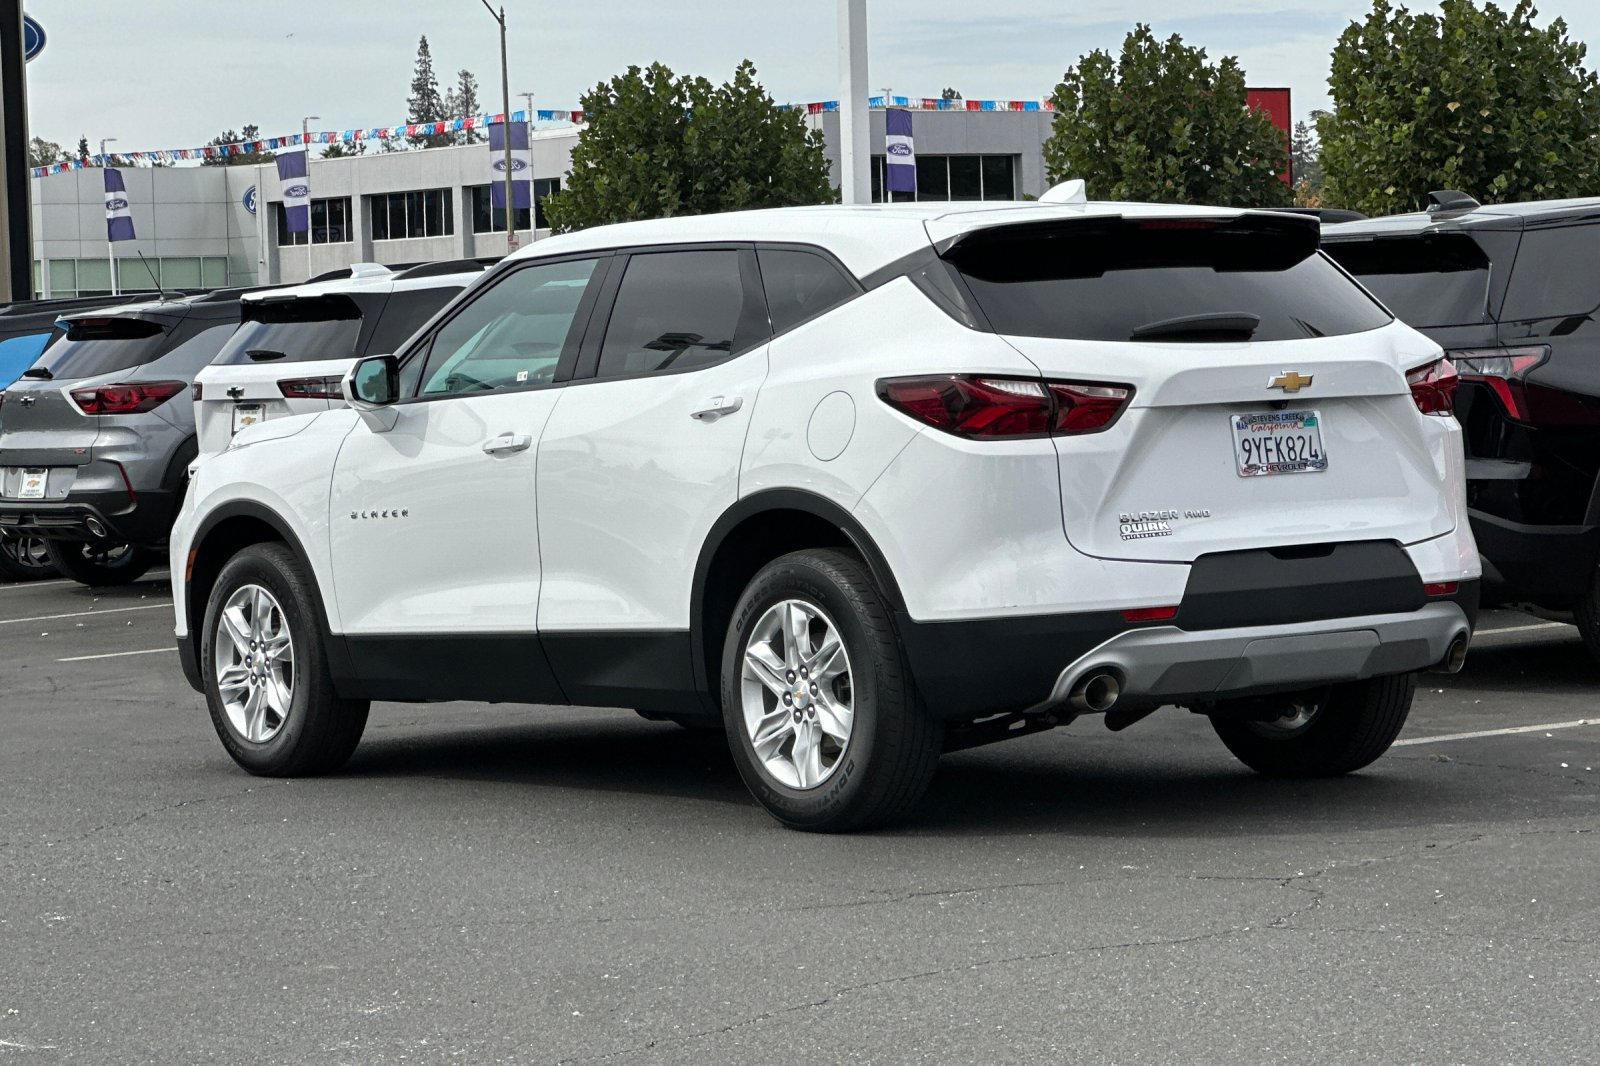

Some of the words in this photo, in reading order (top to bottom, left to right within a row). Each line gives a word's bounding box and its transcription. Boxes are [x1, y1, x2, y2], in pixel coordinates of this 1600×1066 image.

[1252, 414, 1280, 422] STEVENS
[1281, 413, 1301, 421] CREEK
[1251, 421, 1304, 435] California
[1241, 435, 1319, 464] 9YFK824
[1261, 463, 1308, 472] CHEVROLET
[350, 509, 408, 519] BLAZER
[1119, 510, 1179, 523] BLAZER
[1184, 509, 1210, 519] AWD
[1120, 521, 1169, 535] QUIRK
